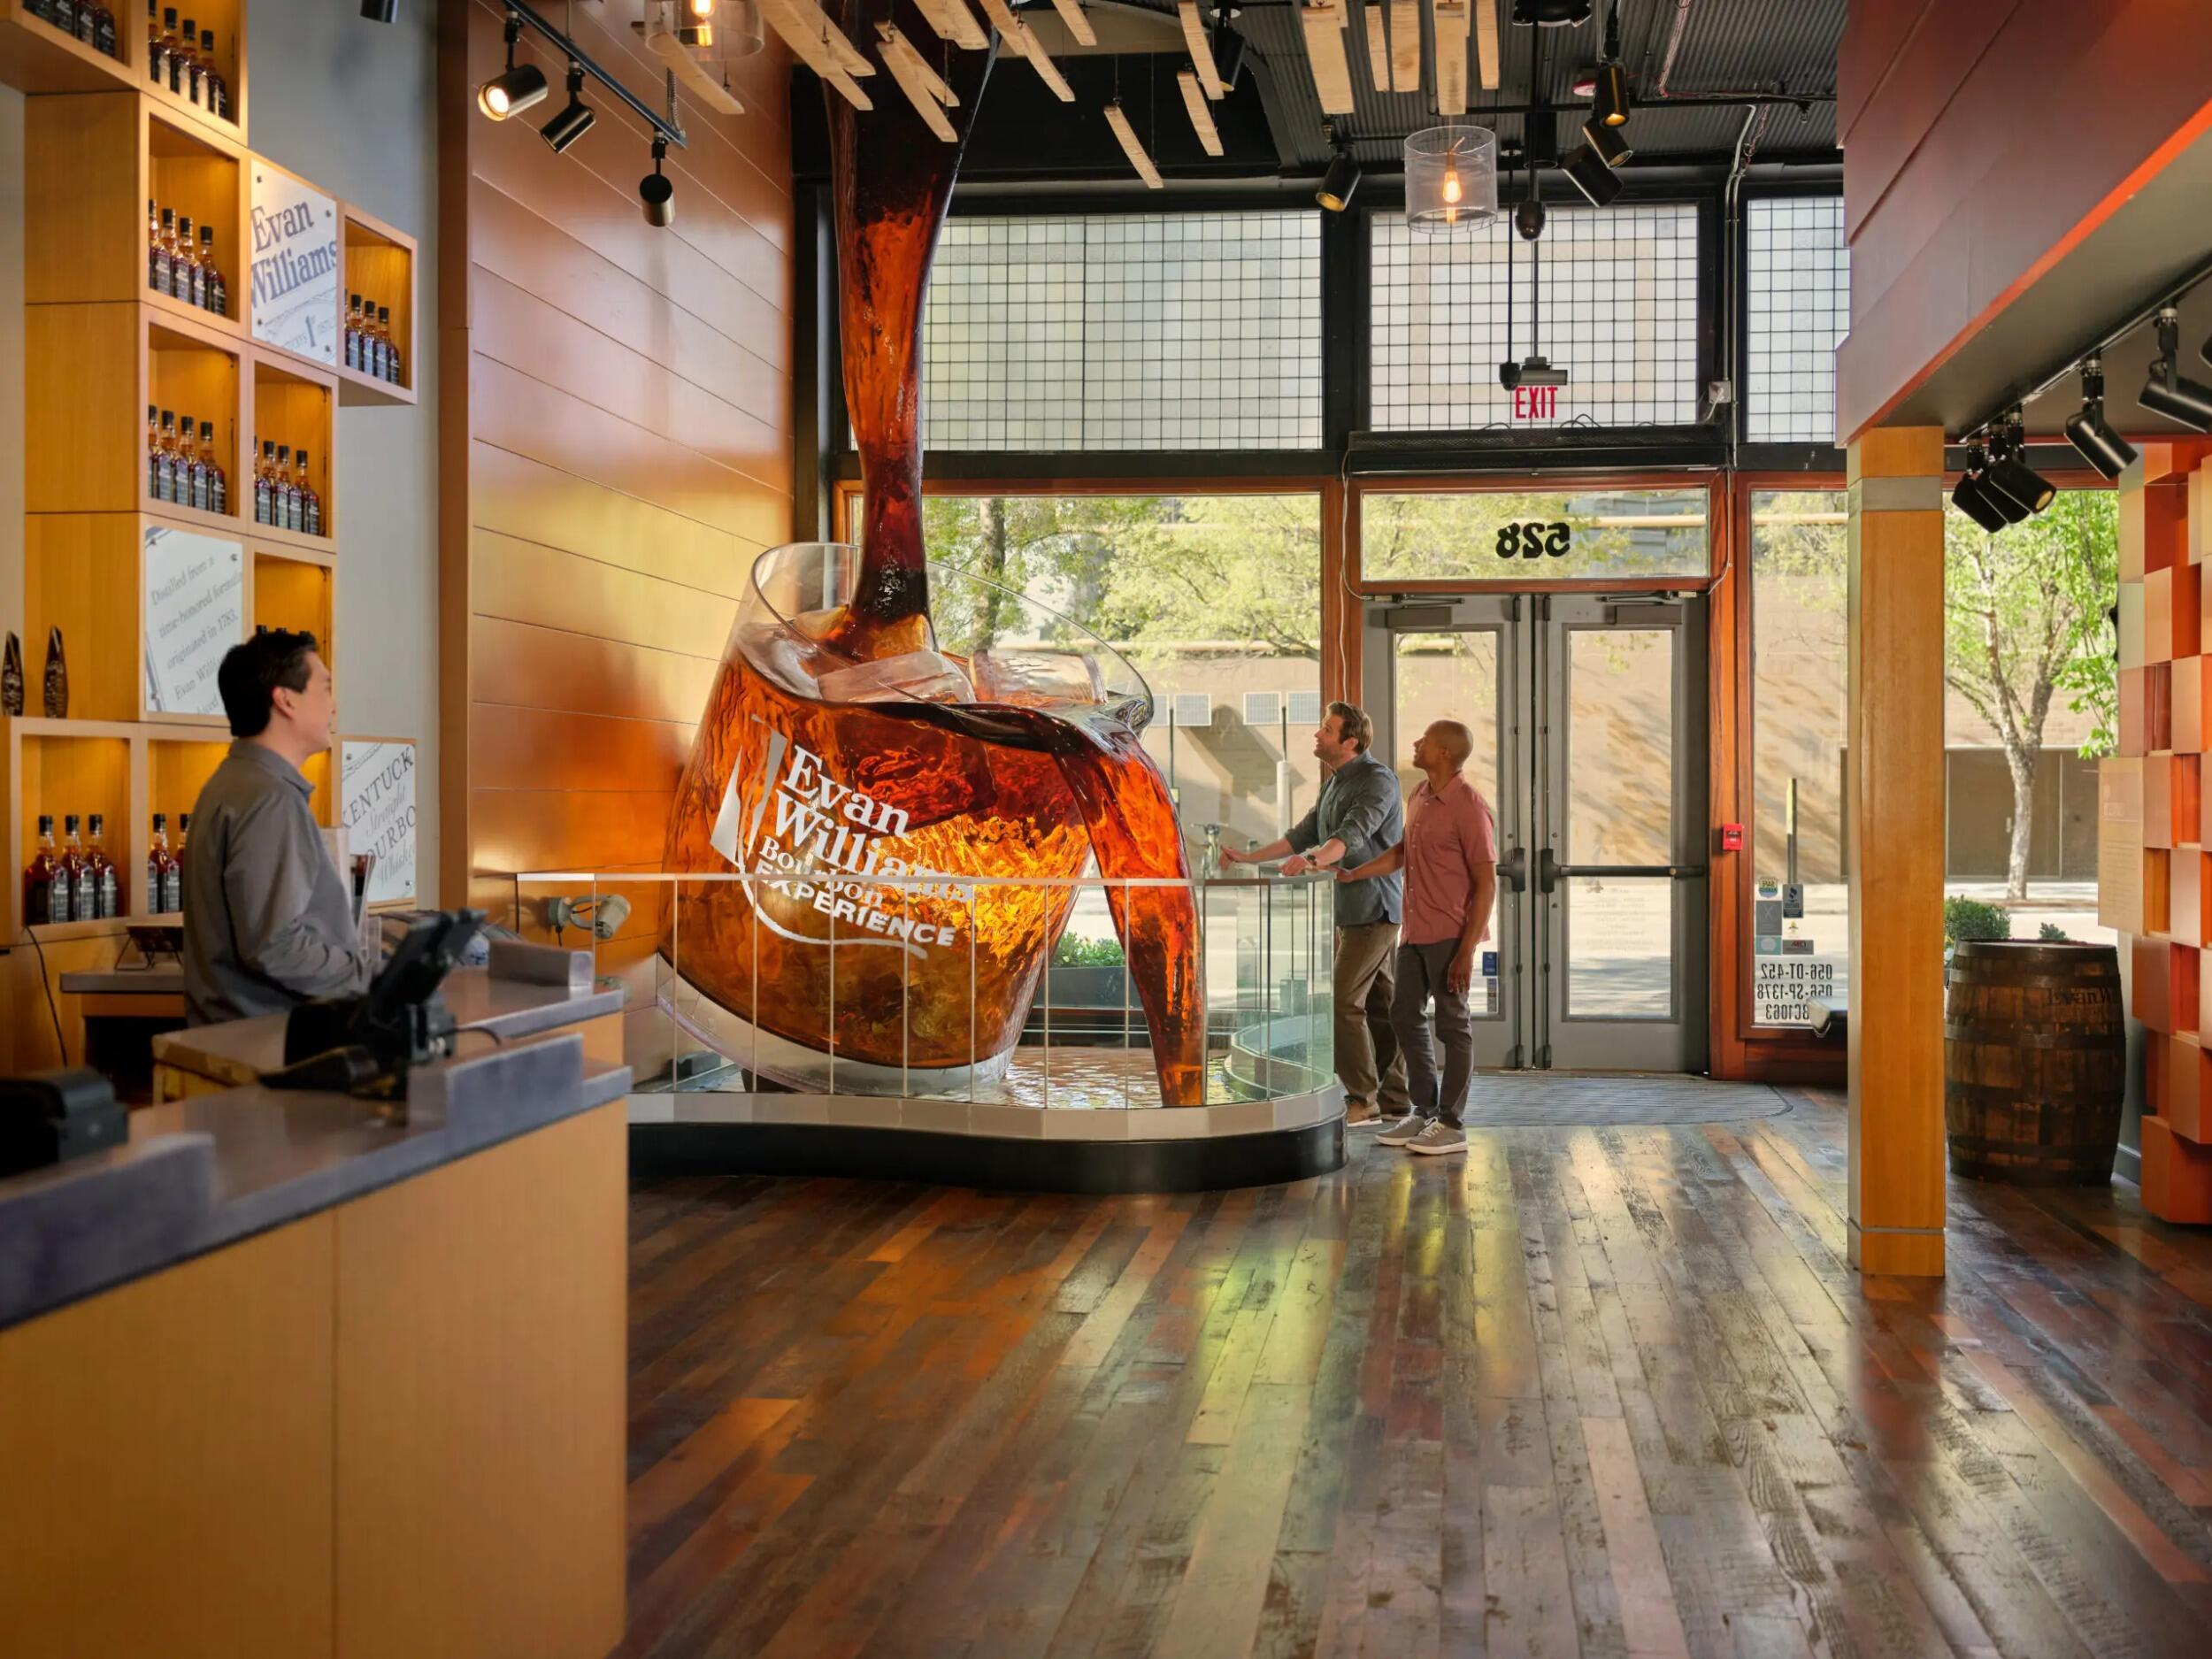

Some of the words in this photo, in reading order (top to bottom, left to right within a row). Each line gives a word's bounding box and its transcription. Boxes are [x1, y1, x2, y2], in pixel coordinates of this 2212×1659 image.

[251, 201, 314, 253] Evan
[251, 240, 336, 309] Williams
[1515, 386, 1558, 419] EXIT
[151, 570, 187, 605] Distilled
[187, 561, 207, 581] from
[174, 680, 196, 701] Evan
[342, 746, 414, 828] KENTUCK
[782, 745, 912, 838] Evan
[775, 788, 974, 902] Williams
[755, 859, 957, 947] EXPERIENCE
